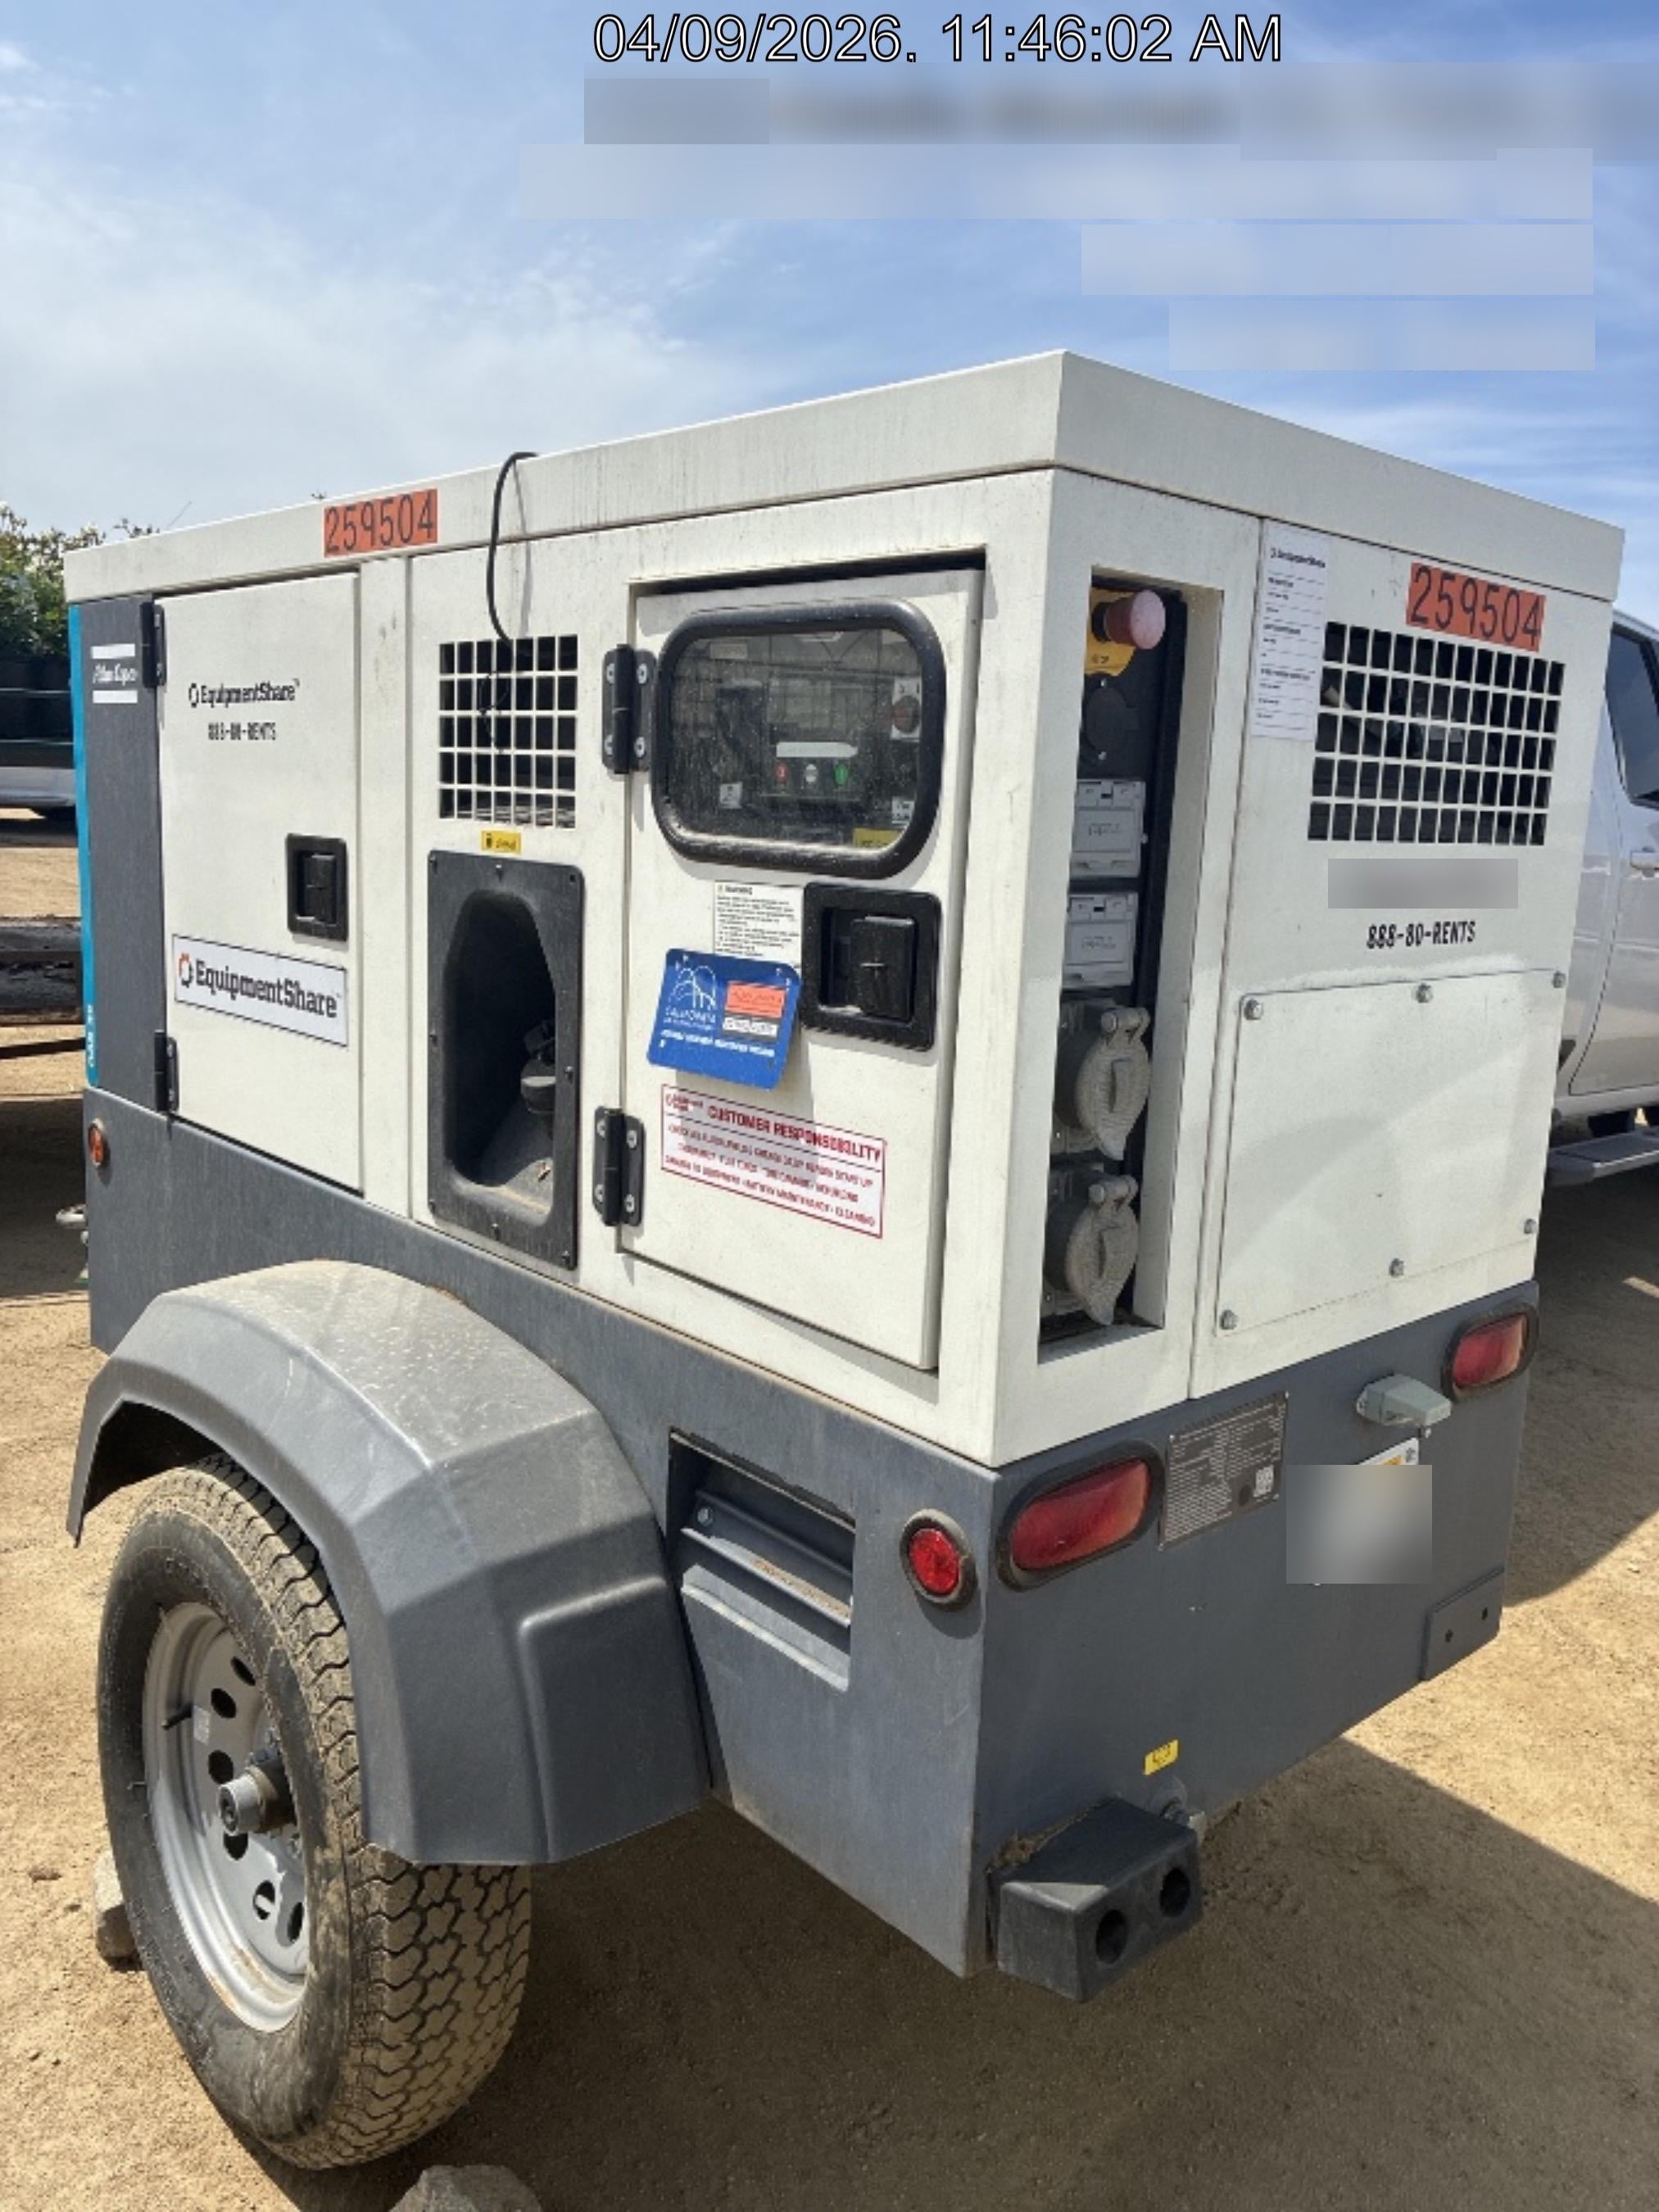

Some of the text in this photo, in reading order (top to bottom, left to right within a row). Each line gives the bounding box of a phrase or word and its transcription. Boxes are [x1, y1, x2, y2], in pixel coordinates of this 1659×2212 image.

[326, 492, 433, 551] 259504
[1411, 565, 1540, 646] 259504
[1367, 920, 1476, 950] 888-80-RENTS
[196, 959, 337, 1018] EquipmentShare
[707, 1105, 770, 1134] CUSTOMER
[773, 1122, 880, 1162] RESPONSIBILITY
